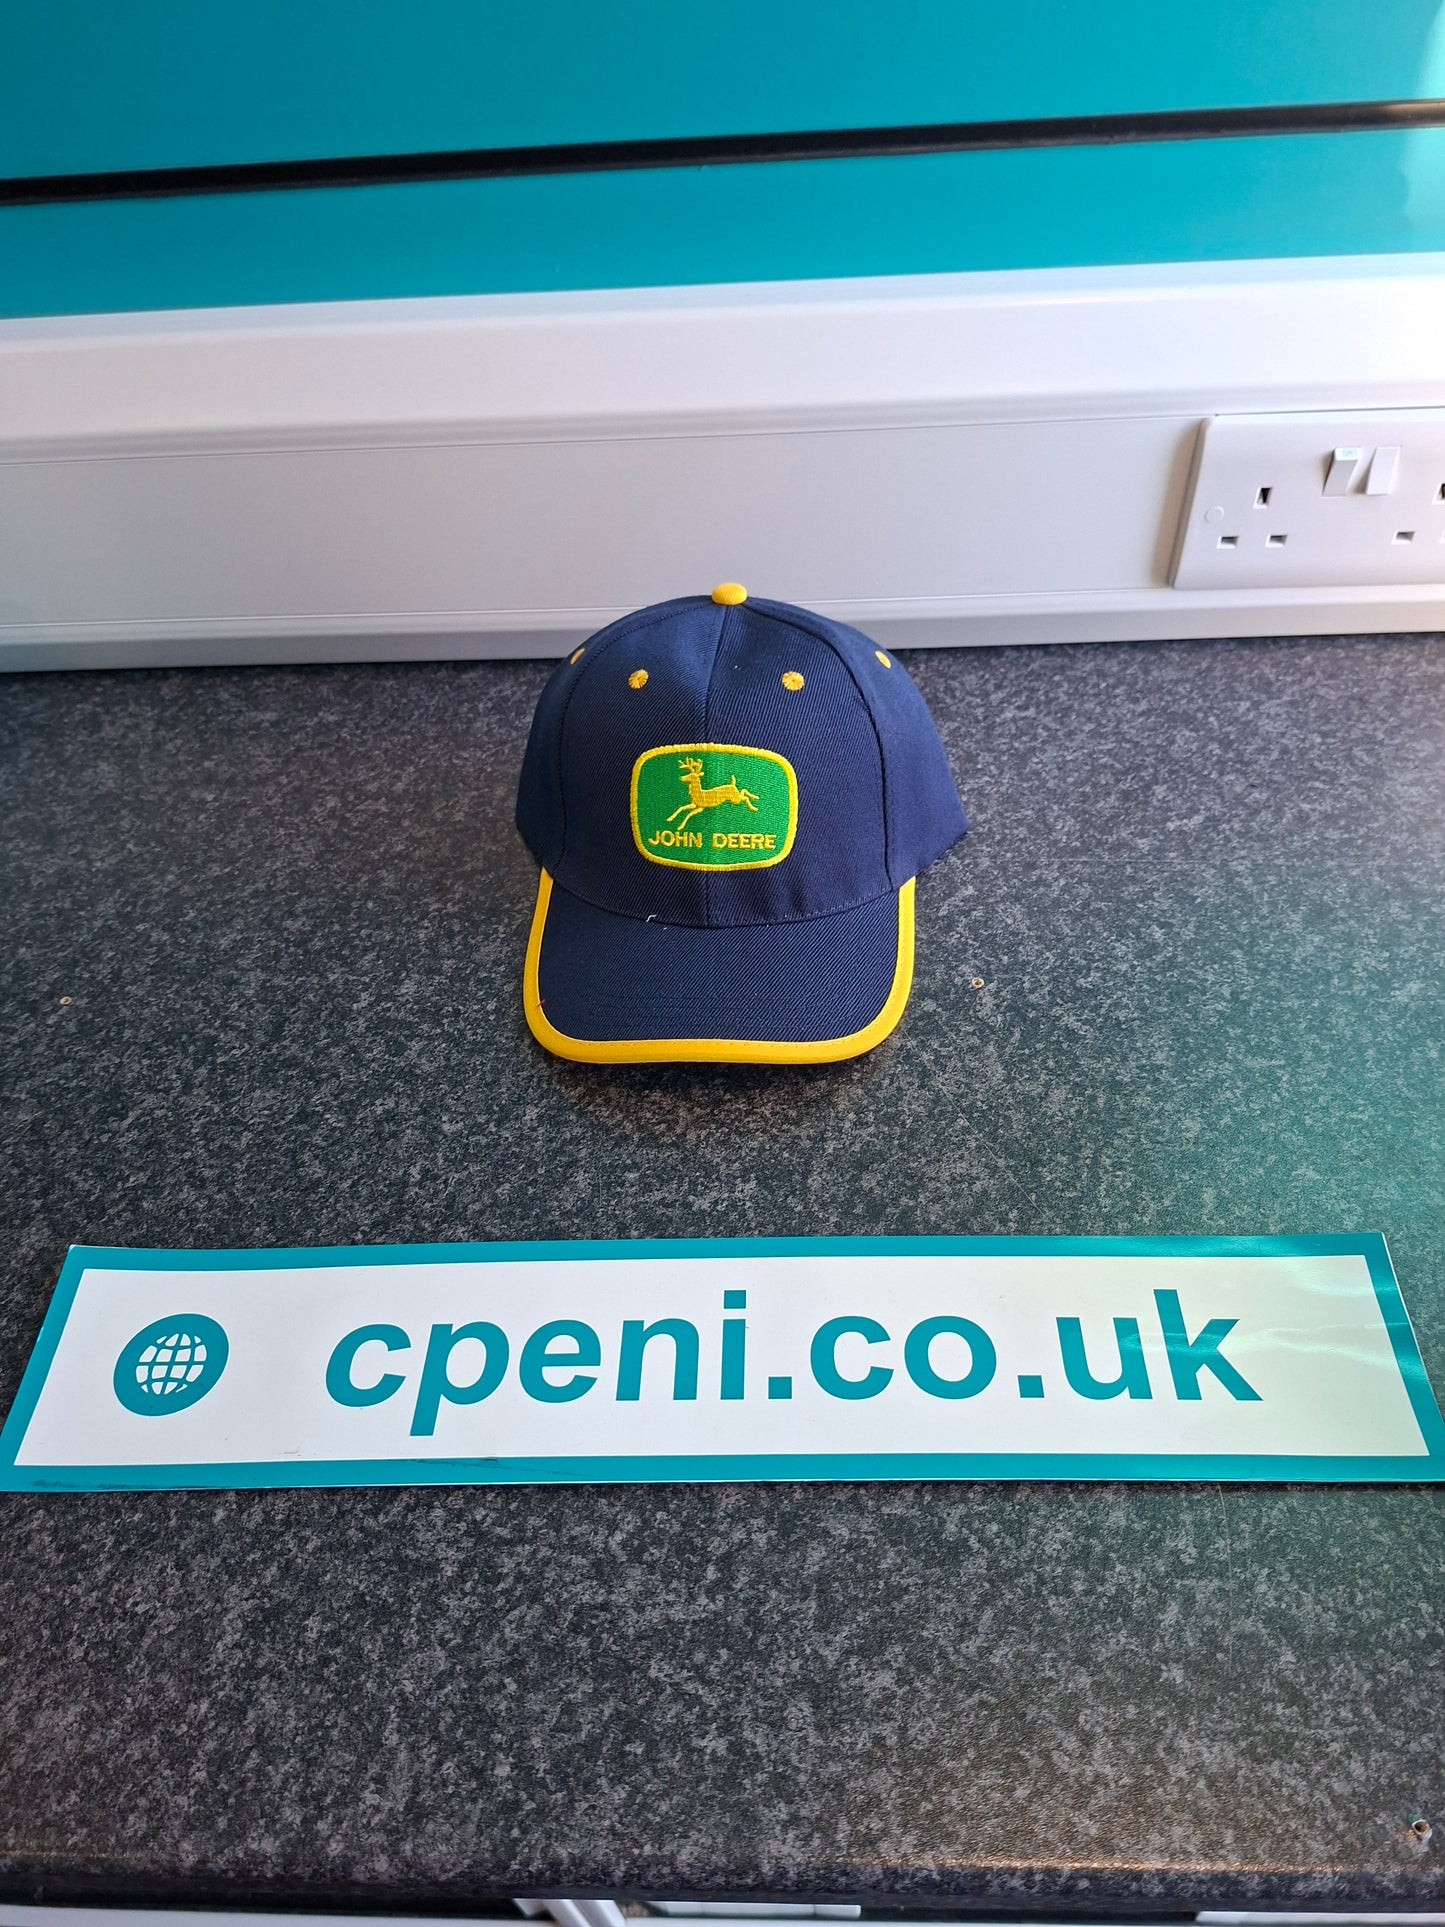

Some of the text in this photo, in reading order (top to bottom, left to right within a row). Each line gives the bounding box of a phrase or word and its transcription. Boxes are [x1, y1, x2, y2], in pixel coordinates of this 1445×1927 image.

[648, 830, 776, 849] JOHN DEERE
[325, 1288, 1262, 1436] cpeni.co.uk
